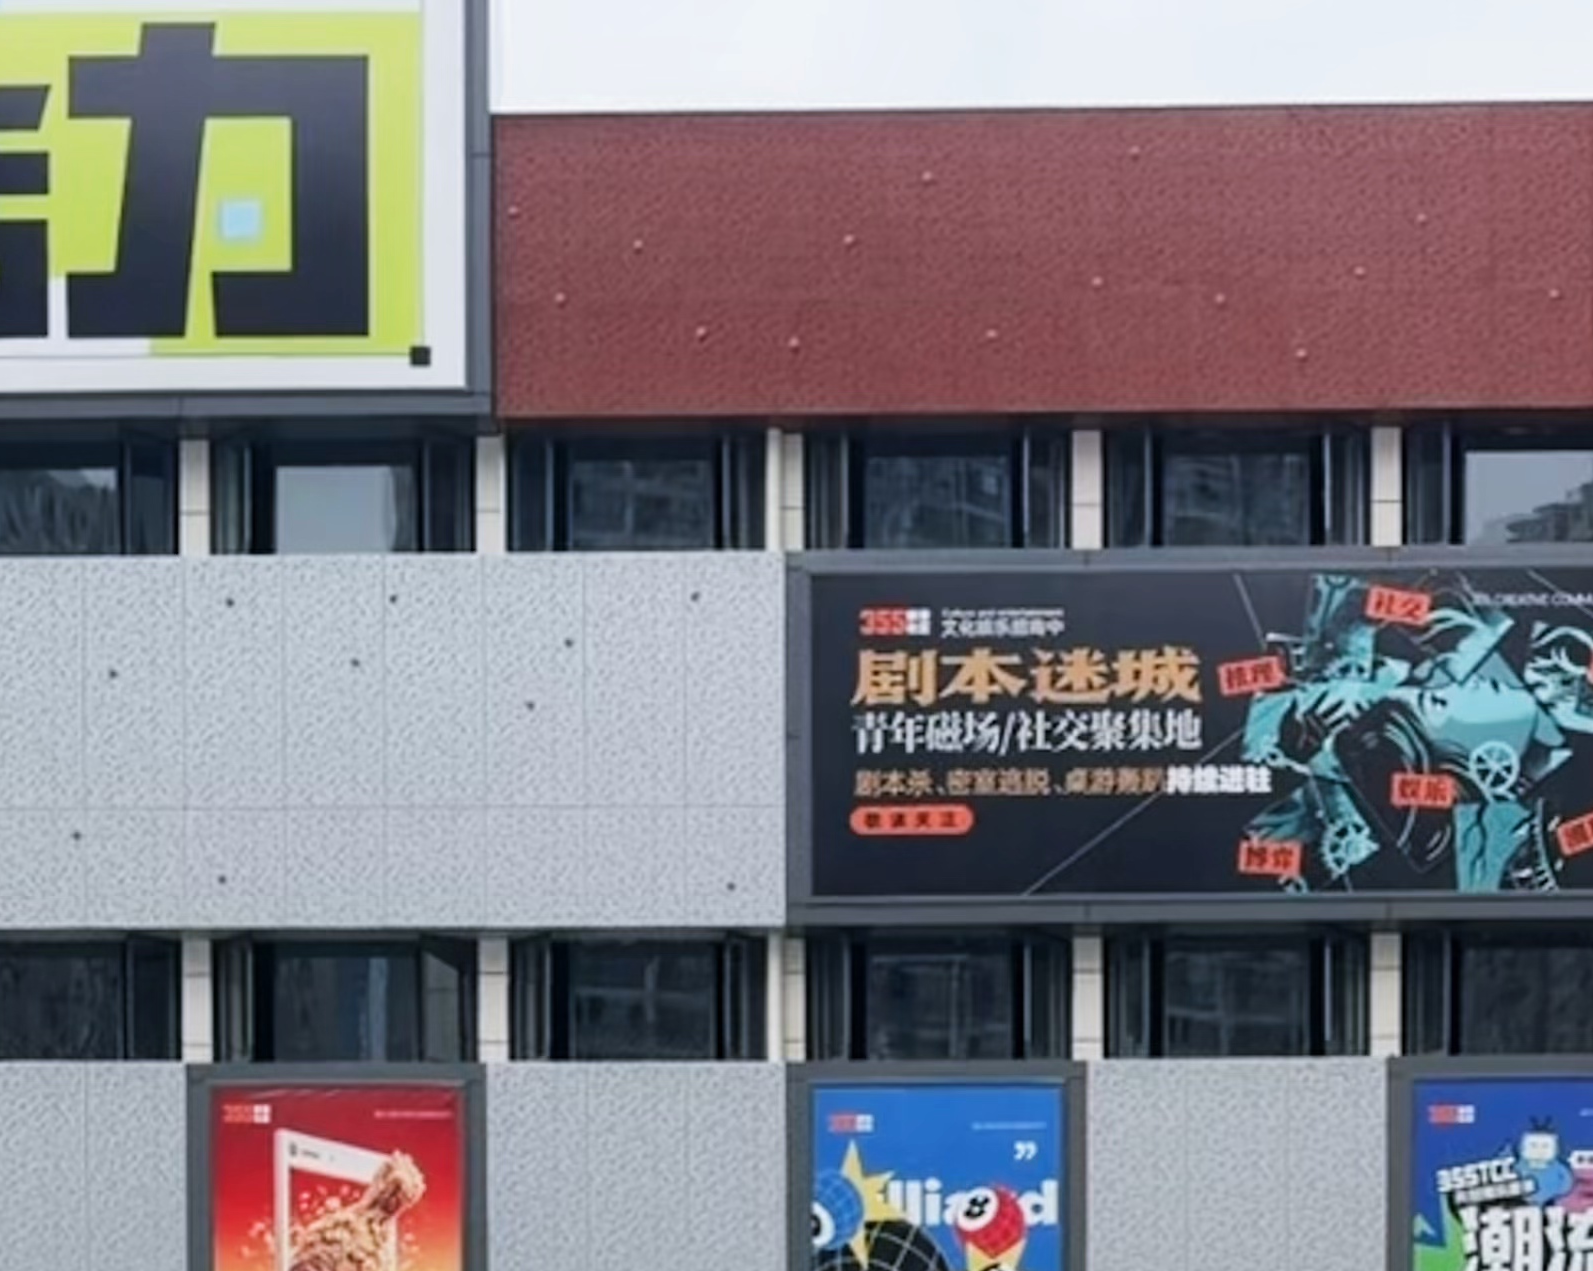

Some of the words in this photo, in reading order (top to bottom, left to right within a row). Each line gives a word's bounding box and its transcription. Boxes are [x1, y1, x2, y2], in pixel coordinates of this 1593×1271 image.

[851, 646, 1204, 706] 剧本迷城
[852, 708, 1204, 756] 青年磁场/社交聚集地
